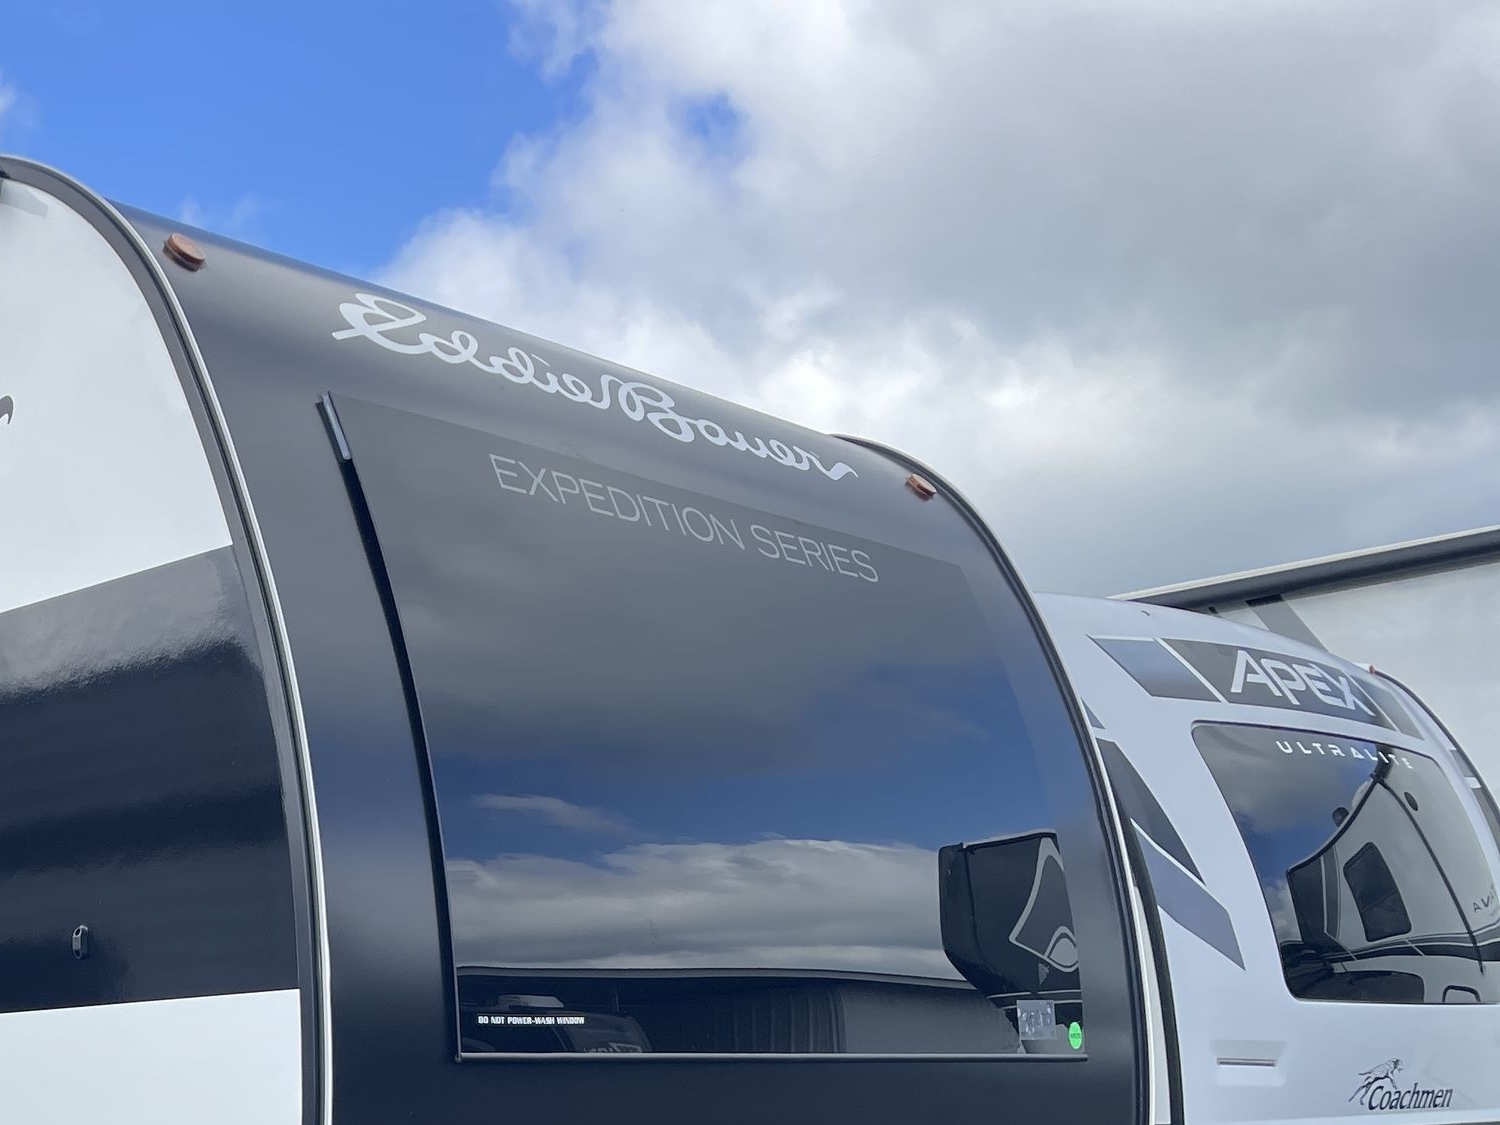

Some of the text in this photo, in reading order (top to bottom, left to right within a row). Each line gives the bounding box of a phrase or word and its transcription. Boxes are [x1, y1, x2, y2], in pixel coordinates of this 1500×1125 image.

[331, 292, 860, 482] Eddie Bauer
[488, 453, 880, 584] EXPEDITION SERIES
[1230, 649, 1377, 718] APEX
[1275, 740, 1414, 770] ULTRALITE
[478, 1016, 585, 1025] DO NOT POWER-WASH WINDOW
[1368, 1082, 1454, 1111] Coachmen
